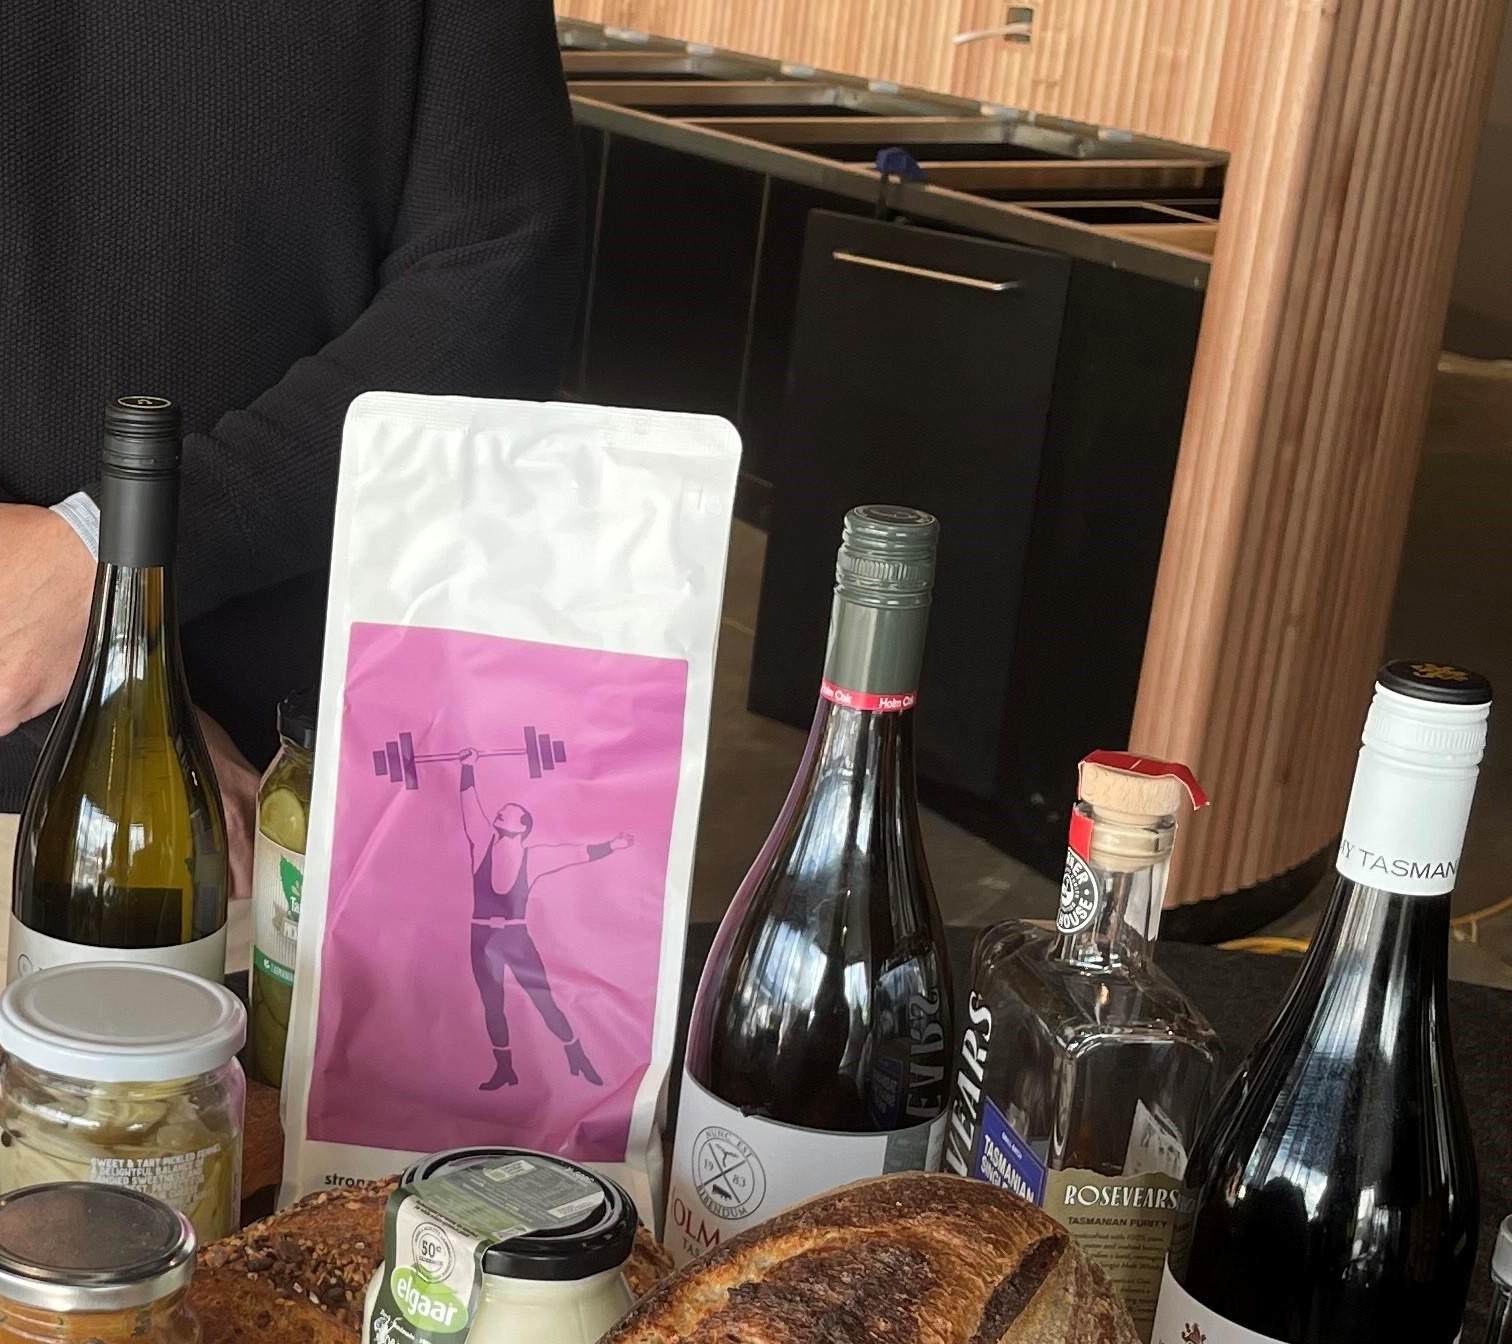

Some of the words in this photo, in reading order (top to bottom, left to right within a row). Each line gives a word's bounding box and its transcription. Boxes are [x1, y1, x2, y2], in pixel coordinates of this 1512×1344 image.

[879, 698, 902, 709] Holm
[703, 1158, 714, 1172] 19
[984, 1134, 1036, 1204] TASMANIAN
[325, 1173, 376, 1187] stron
[1064, 1185, 1180, 1210] ROSEVEARS
[1068, 1216, 1128, 1227] TASMANIAN
[1129, 1219, 1169, 1228] PURITY
[396, 1277, 458, 1326] elgaar
